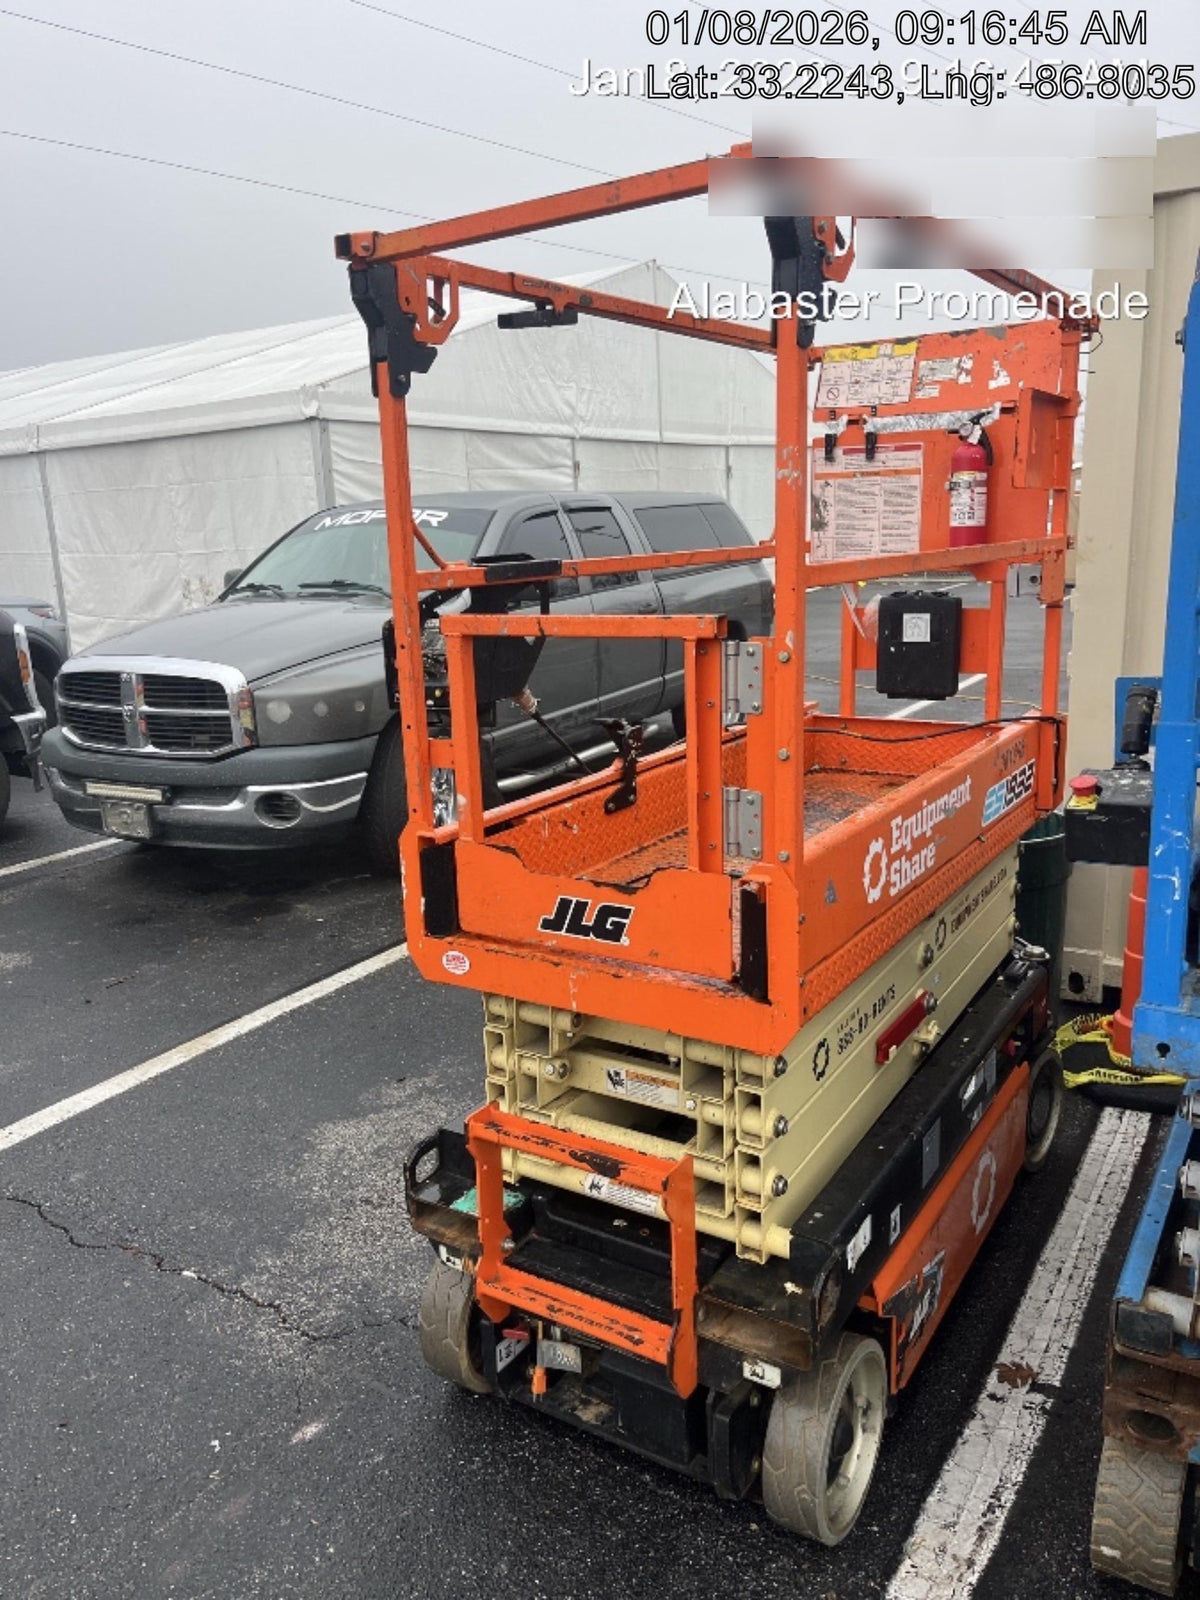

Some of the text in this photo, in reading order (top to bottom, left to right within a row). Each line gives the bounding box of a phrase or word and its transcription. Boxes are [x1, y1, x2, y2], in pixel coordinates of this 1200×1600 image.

[314, 508, 448, 530] MOPR
[890, 774, 971, 854] Equipment
[889, 842, 936, 897] Share
[538, 895, 635, 945] JLG
